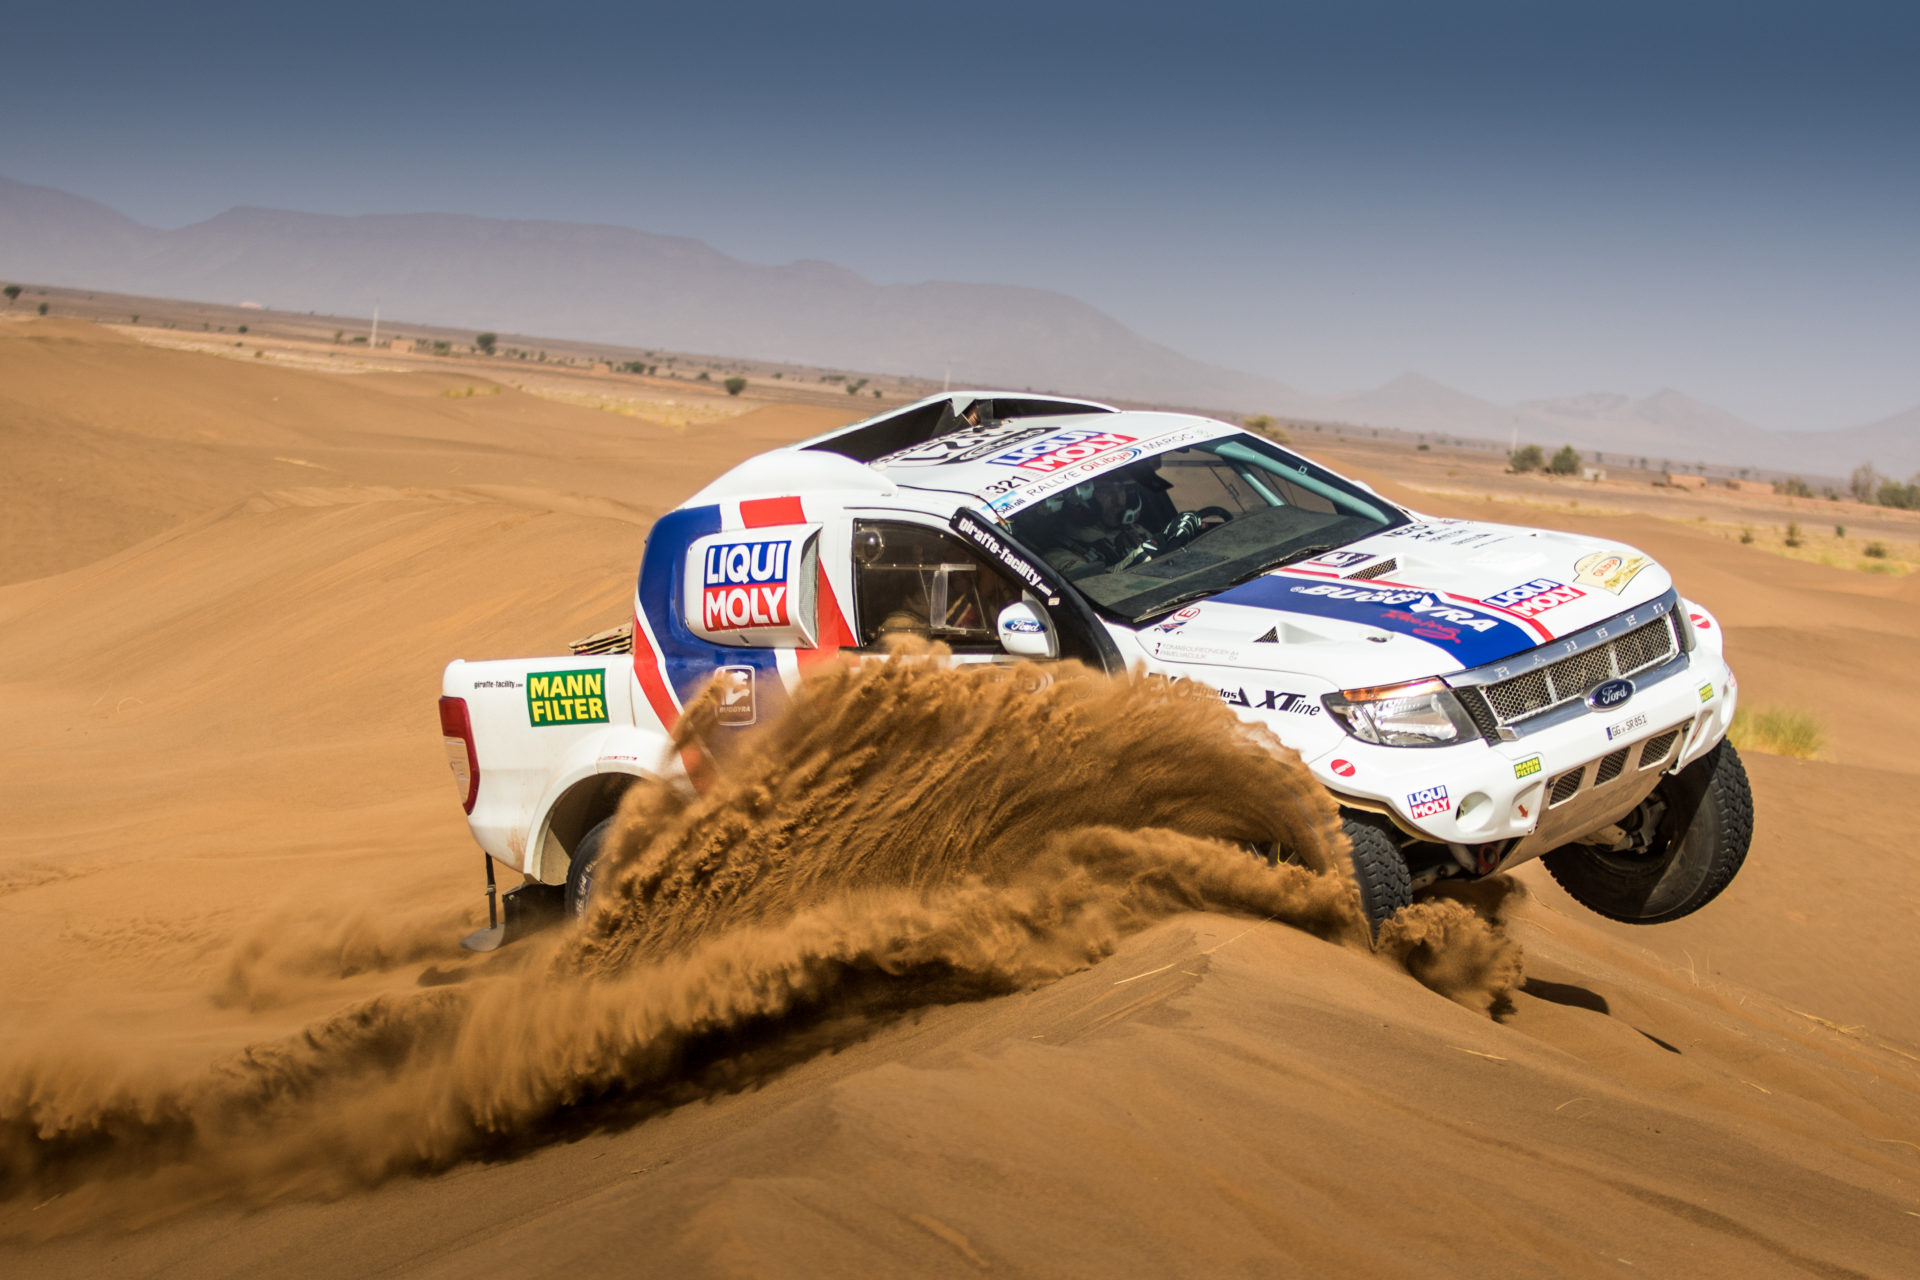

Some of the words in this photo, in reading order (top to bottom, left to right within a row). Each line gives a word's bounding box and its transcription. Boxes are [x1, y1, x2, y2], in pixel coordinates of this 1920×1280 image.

[988, 431, 1102, 466] LIQUI
[1023, 433, 1130, 472] MOLY
[1026, 471, 1081, 497] RALLYE
[1142, 433, 1195, 451] MAROC
[985, 475, 1031, 494] 321
[706, 543, 788, 585] LIQUI
[1486, 579, 1562, 609] LIQUI
[1510, 586, 1580, 617] MOLY
[705, 586, 786, 629] MOLY
[1303, 584, 1499, 633] BUGGYRA
[1011, 620, 1039, 633] Ford
[530, 673, 602, 699] MANN
[1602, 684, 1628, 705] Ford
[531, 697, 605, 722] FILTER
[1255, 690, 1321, 717] XTline
[1515, 758, 1539, 772] MANN
[1516, 765, 1540, 778] FILTER
[1409, 786, 1446, 807] LIQUI
[1412, 799, 1450, 819] MOLY
